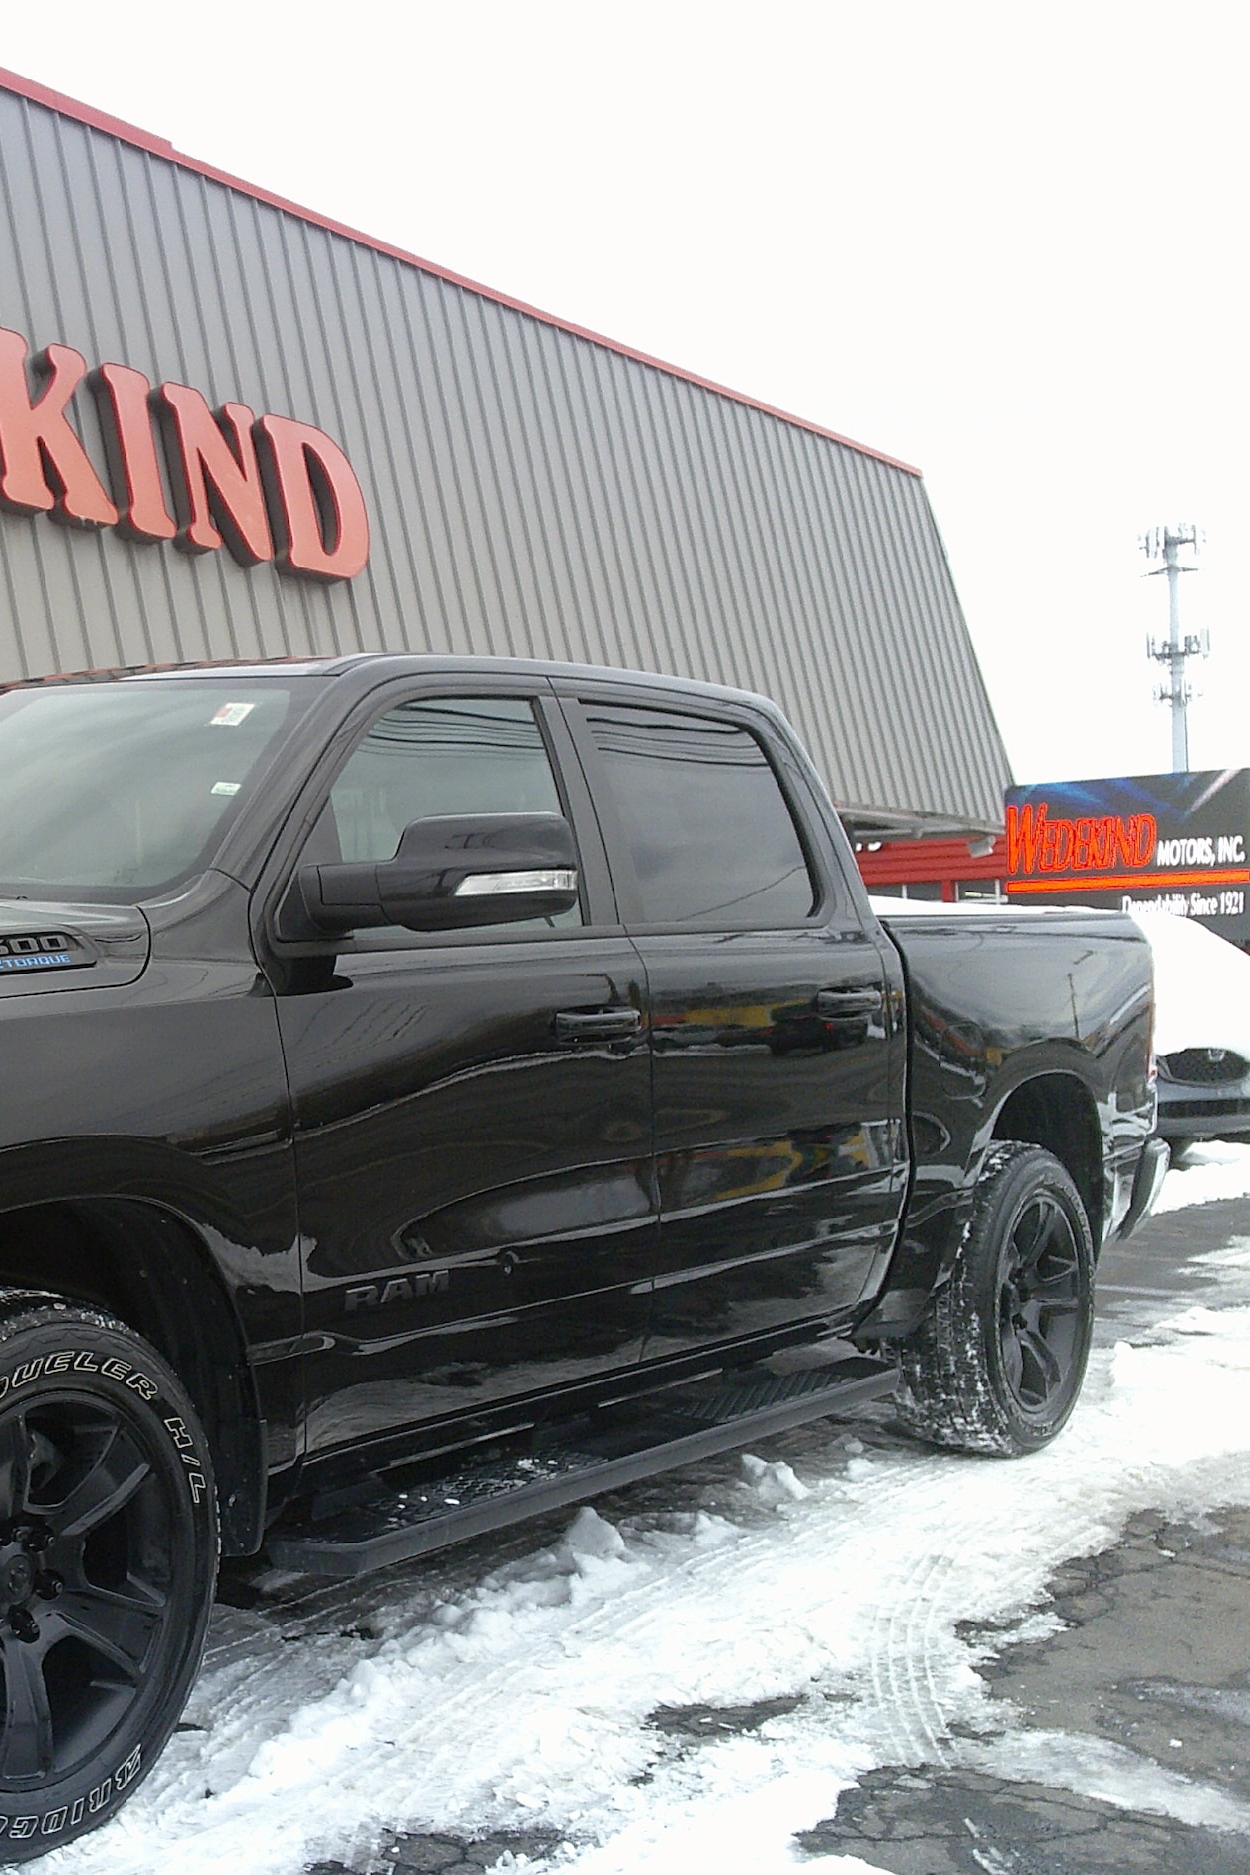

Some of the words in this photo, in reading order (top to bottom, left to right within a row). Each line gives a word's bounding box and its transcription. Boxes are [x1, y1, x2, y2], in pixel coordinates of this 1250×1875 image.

[1006, 802, 1158, 876] WEDEKIND
[1156, 838, 1216, 868] MOTORS,
[1217, 834, 1246, 864] INC.
[1190, 892, 1218, 916] Since
[1219, 890, 1245, 915] 1921
[344, 1269, 449, 1311] RAM
